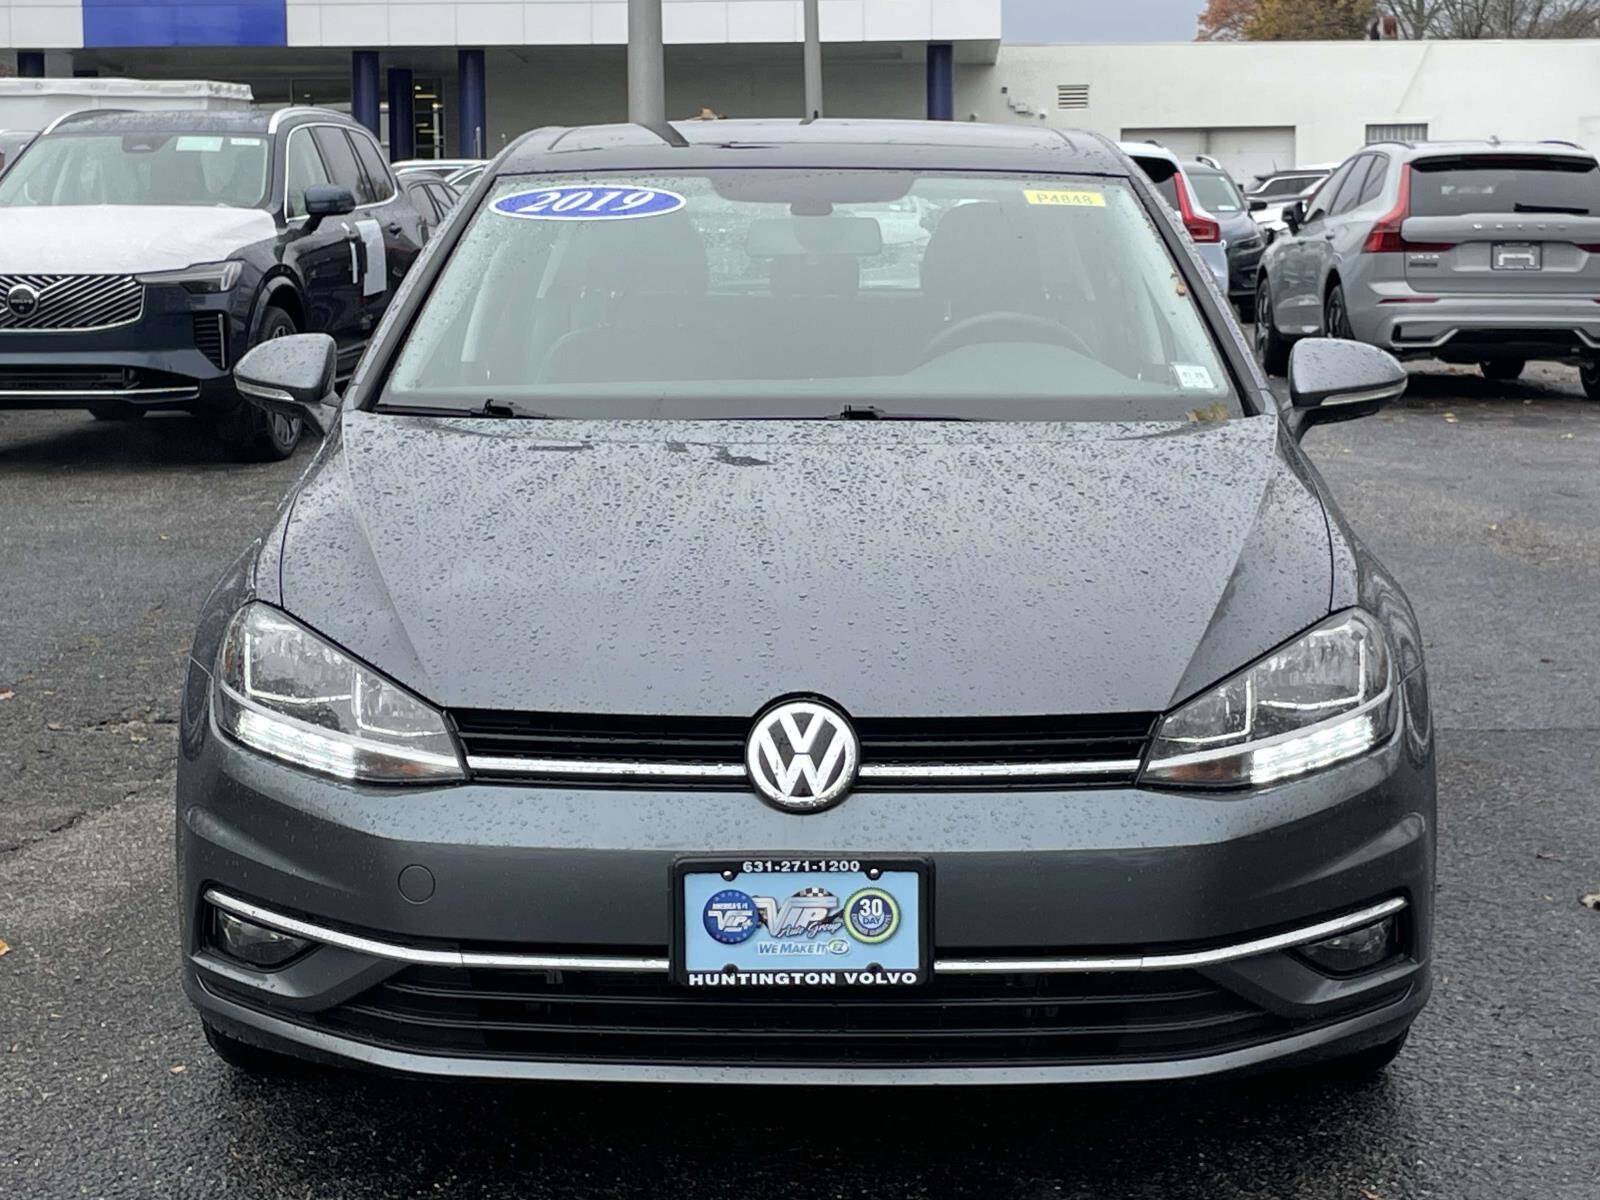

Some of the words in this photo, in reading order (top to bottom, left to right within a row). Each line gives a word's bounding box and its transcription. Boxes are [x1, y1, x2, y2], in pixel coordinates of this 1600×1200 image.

[516, 190, 655, 213] 2019
[742, 860, 861, 873] 631-271-1200
[860, 898, 883, 917] 30
[752, 896, 838, 937] VIP
[862, 917, 881, 925] DAY
[688, 972, 836, 987] HUNTINGTON
[843, 972, 917, 986] VOLVO
